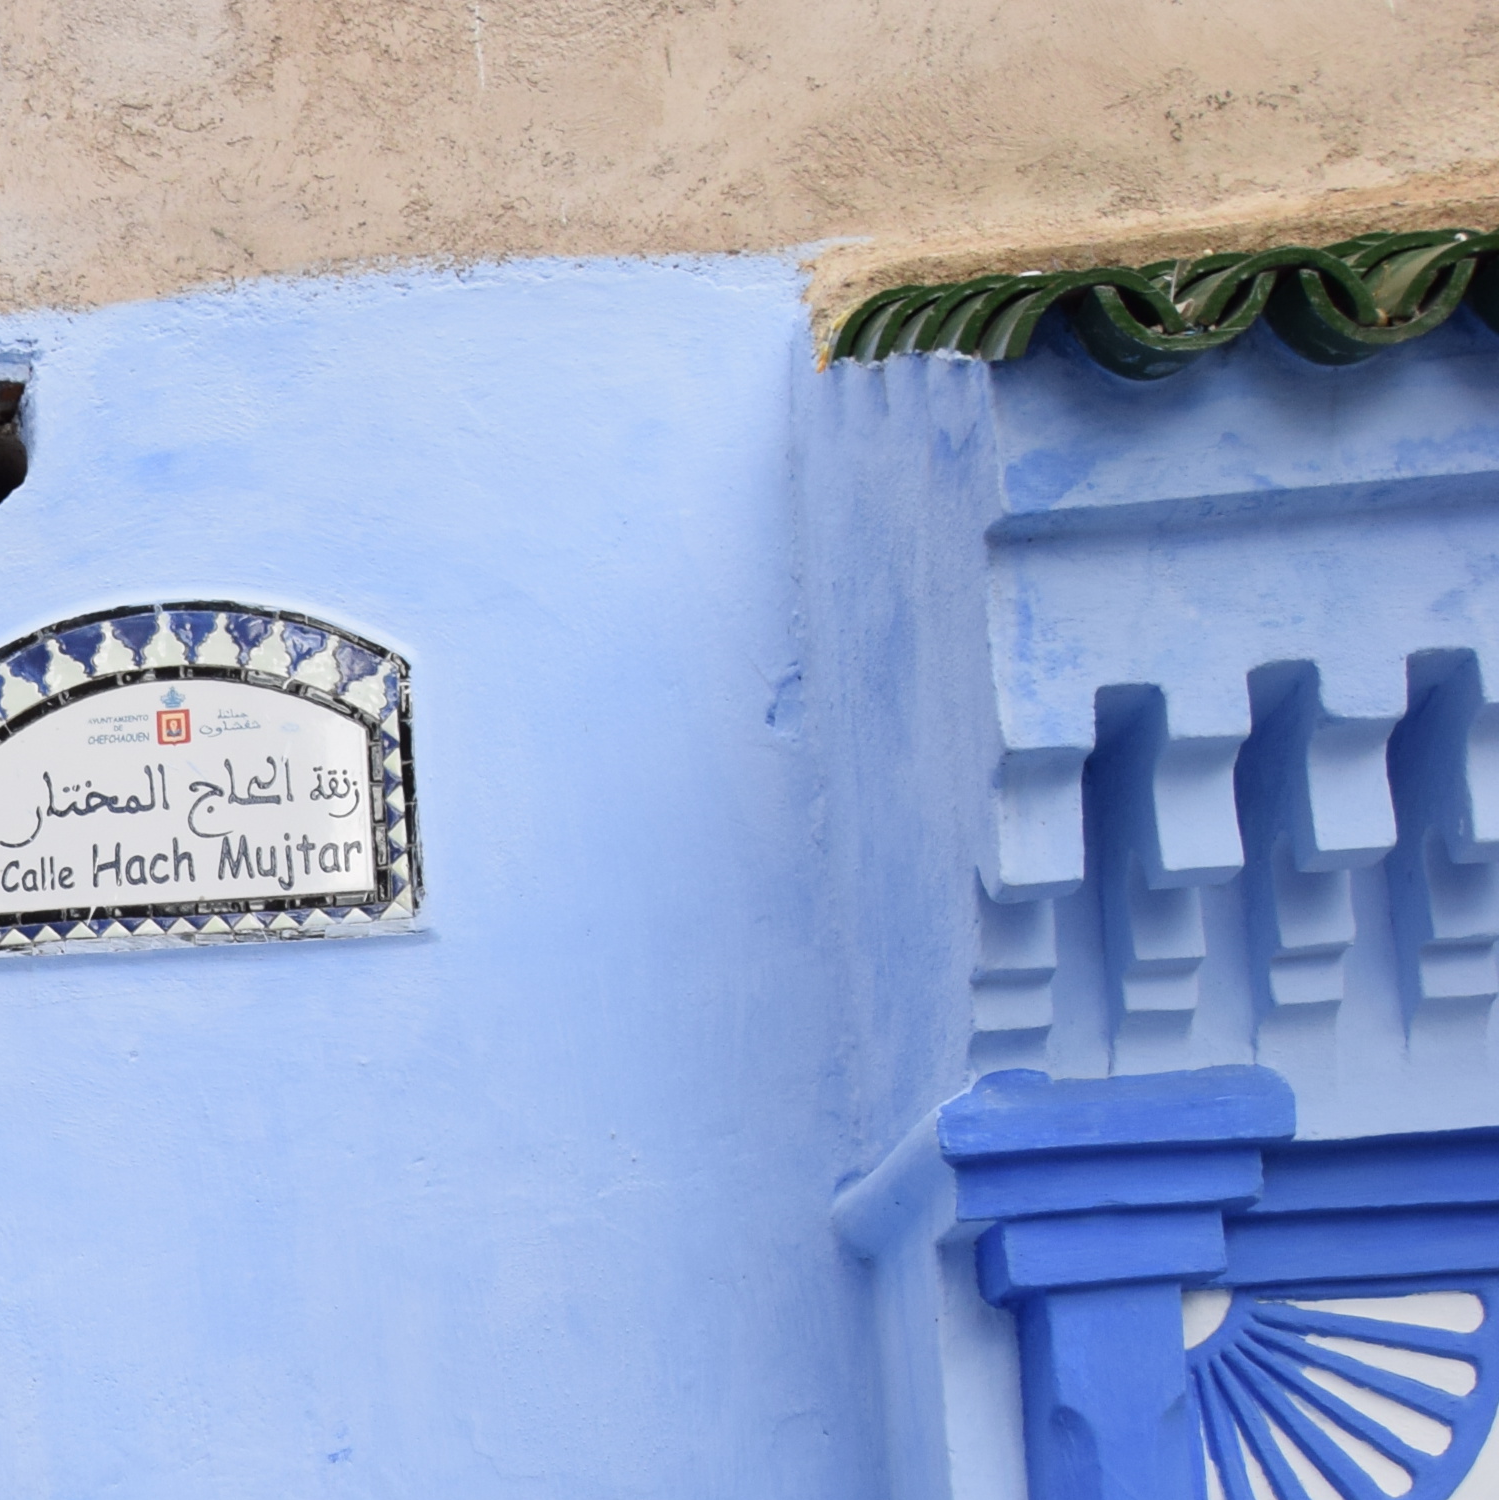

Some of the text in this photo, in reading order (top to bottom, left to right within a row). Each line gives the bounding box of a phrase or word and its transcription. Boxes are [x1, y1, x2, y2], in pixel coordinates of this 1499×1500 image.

[88, 714, 149, 724] AYUNTAMIENTO
[113, 724, 123, 732] DE
[199, 720, 262, 738] شفشاون
[87, 731, 150, 745] CHEFCHAOUEN
[0, 755, 361, 849] زنقة الحاج المختار
[1, 833, 364, 893] Calle Hach Mujtar
